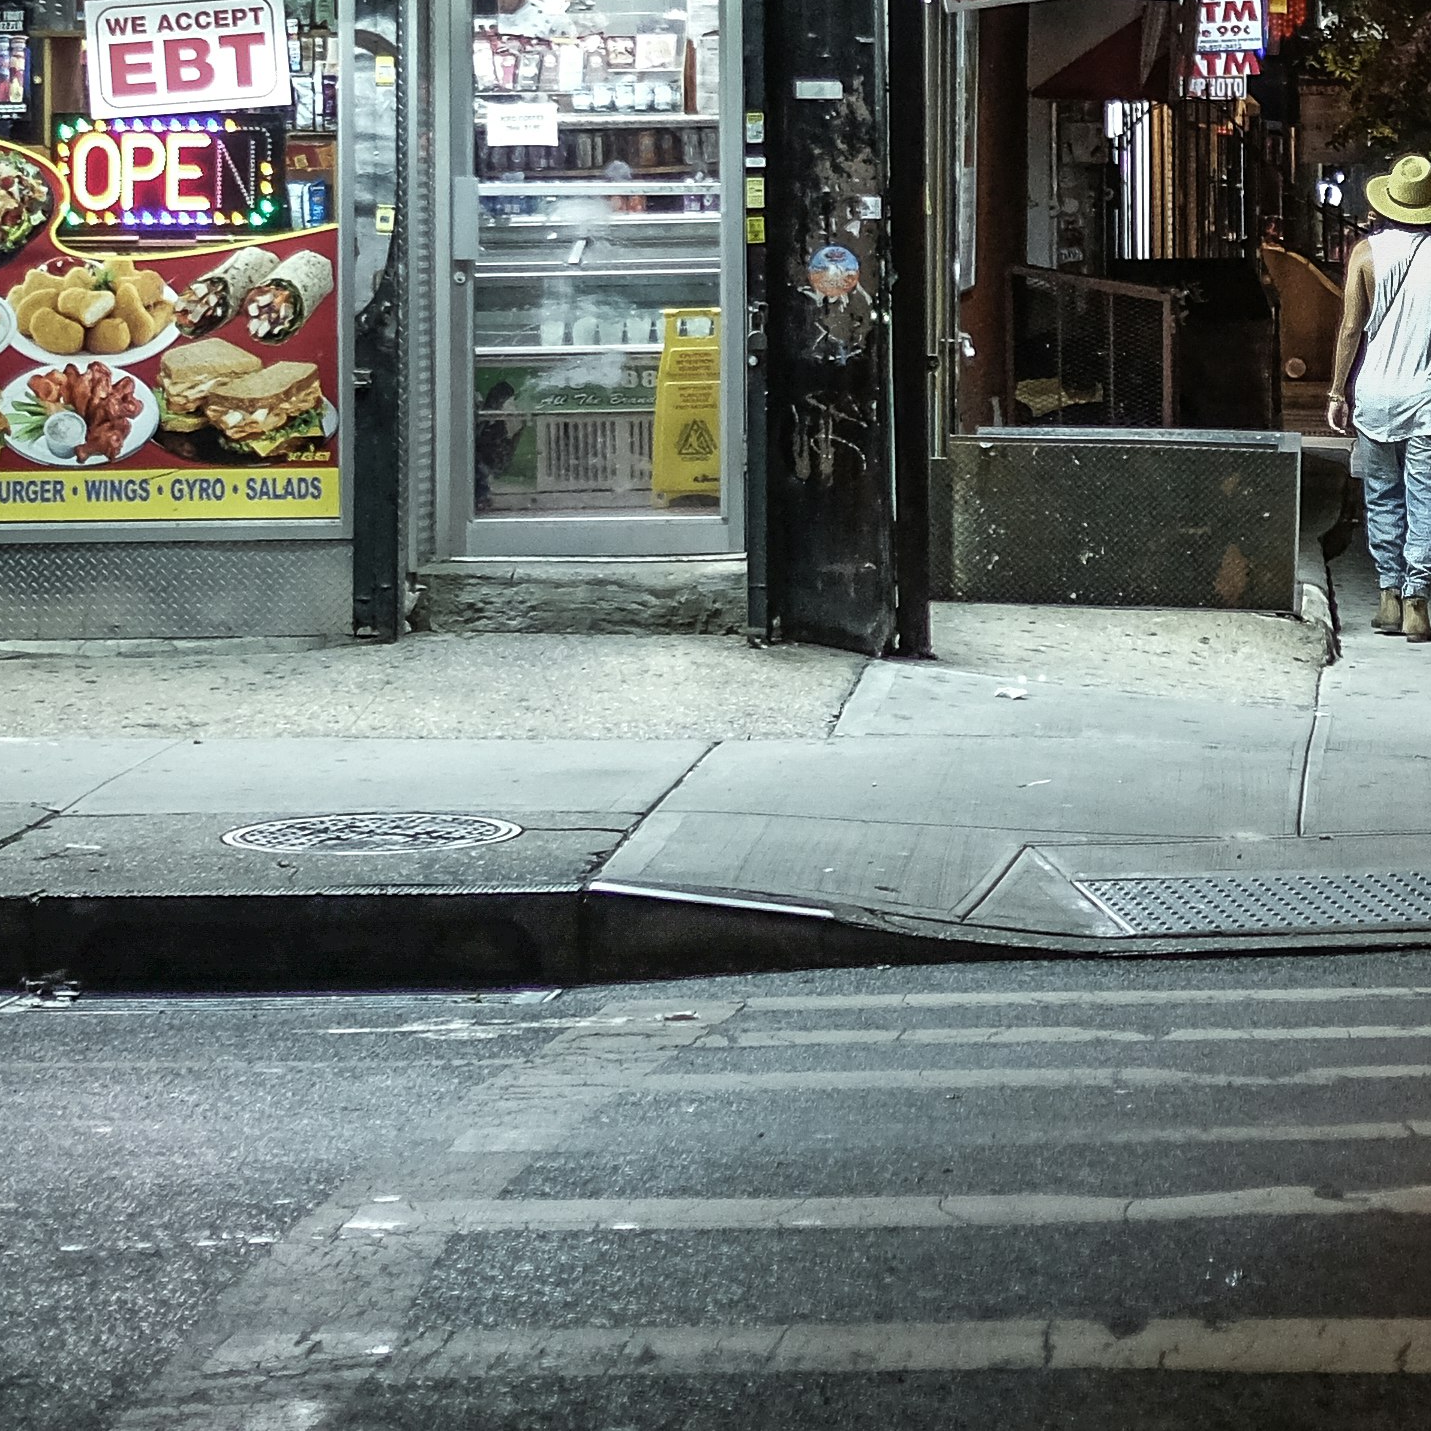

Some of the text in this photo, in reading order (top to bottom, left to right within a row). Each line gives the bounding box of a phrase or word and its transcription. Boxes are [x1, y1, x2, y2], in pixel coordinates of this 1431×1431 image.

[106, 6, 264, 36] WE ACCEPT
[1201, 0, 1259, 23] TM
[110, 32, 267, 97] EBT
[71, 132, 255, 212] OPEN
[84, 477, 151, 504] WINGS
[170, 477, 226, 504] GYRO
[245, 475, 322, 502] SALADS
